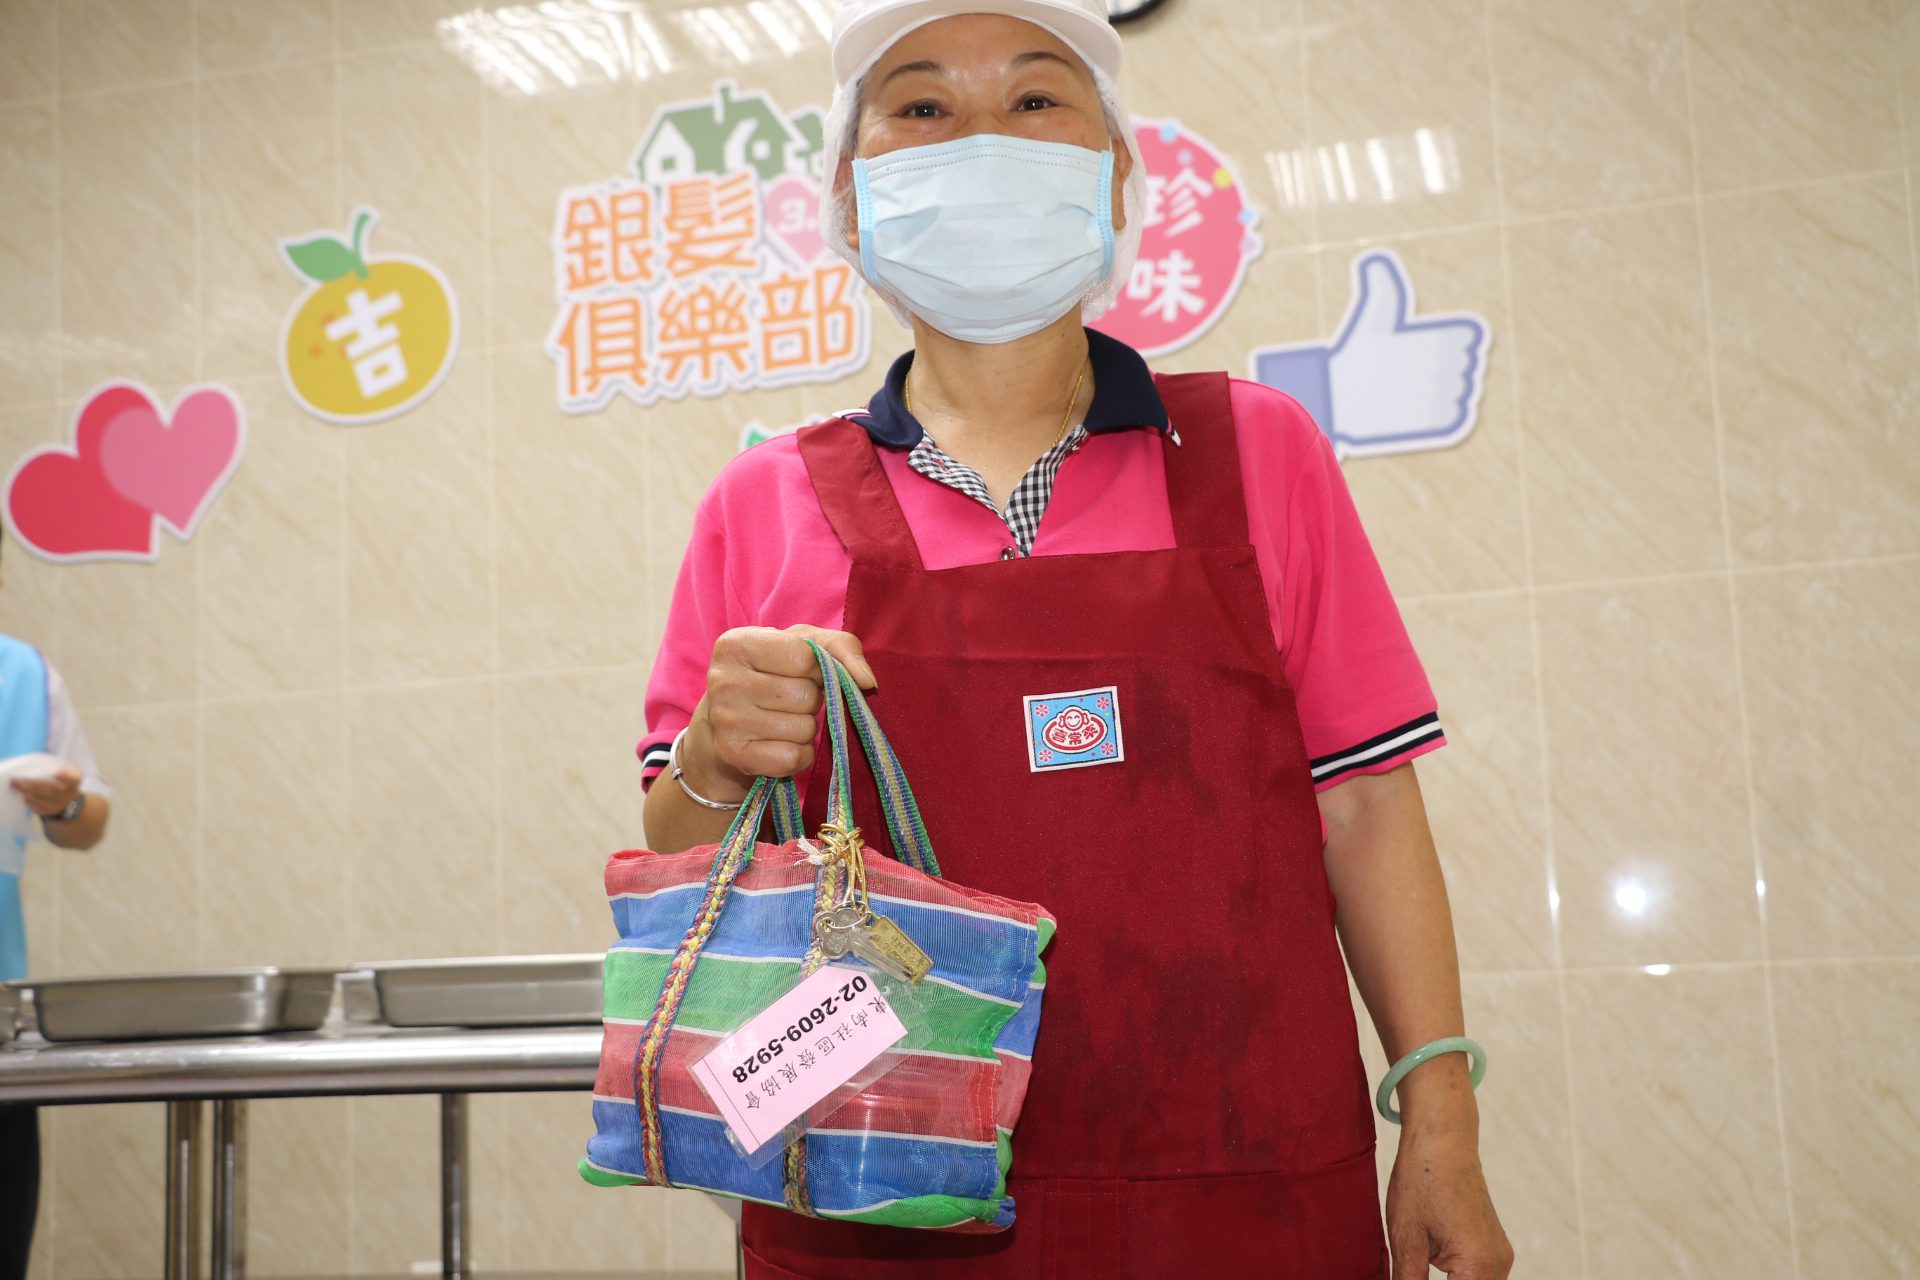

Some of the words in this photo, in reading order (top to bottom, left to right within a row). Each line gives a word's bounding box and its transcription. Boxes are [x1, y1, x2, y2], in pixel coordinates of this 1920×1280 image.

[565, 173, 756, 292] 銀髮
[1108, 249, 1206, 323] 味
[324, 288, 409, 399] 吉
[558, 265, 853, 397] 俱樂部
[732, 975, 868, 1083] 02-2609-5928
[747, 996, 887, 1109] 東南社區發展協會
